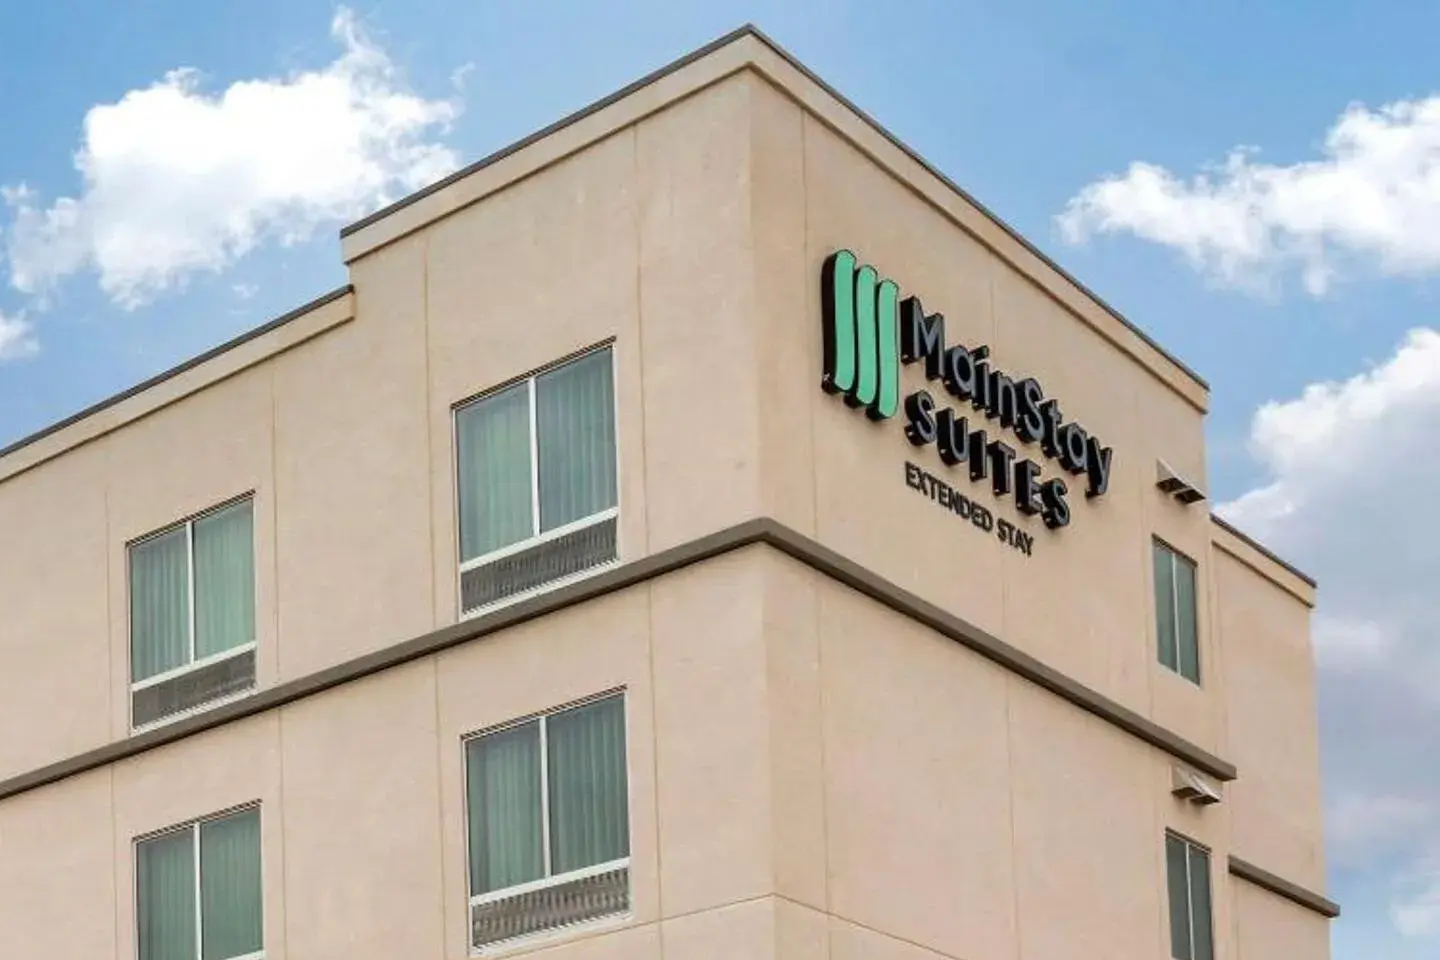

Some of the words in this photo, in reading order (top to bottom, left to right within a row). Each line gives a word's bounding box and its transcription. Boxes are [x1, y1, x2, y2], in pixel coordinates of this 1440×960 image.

[900, 295, 1112, 499] MainStay
[904, 389, 1070, 530] SUITES
[905, 461, 994, 533] EXTENDED
[998, 518, 1034, 556] STAY
